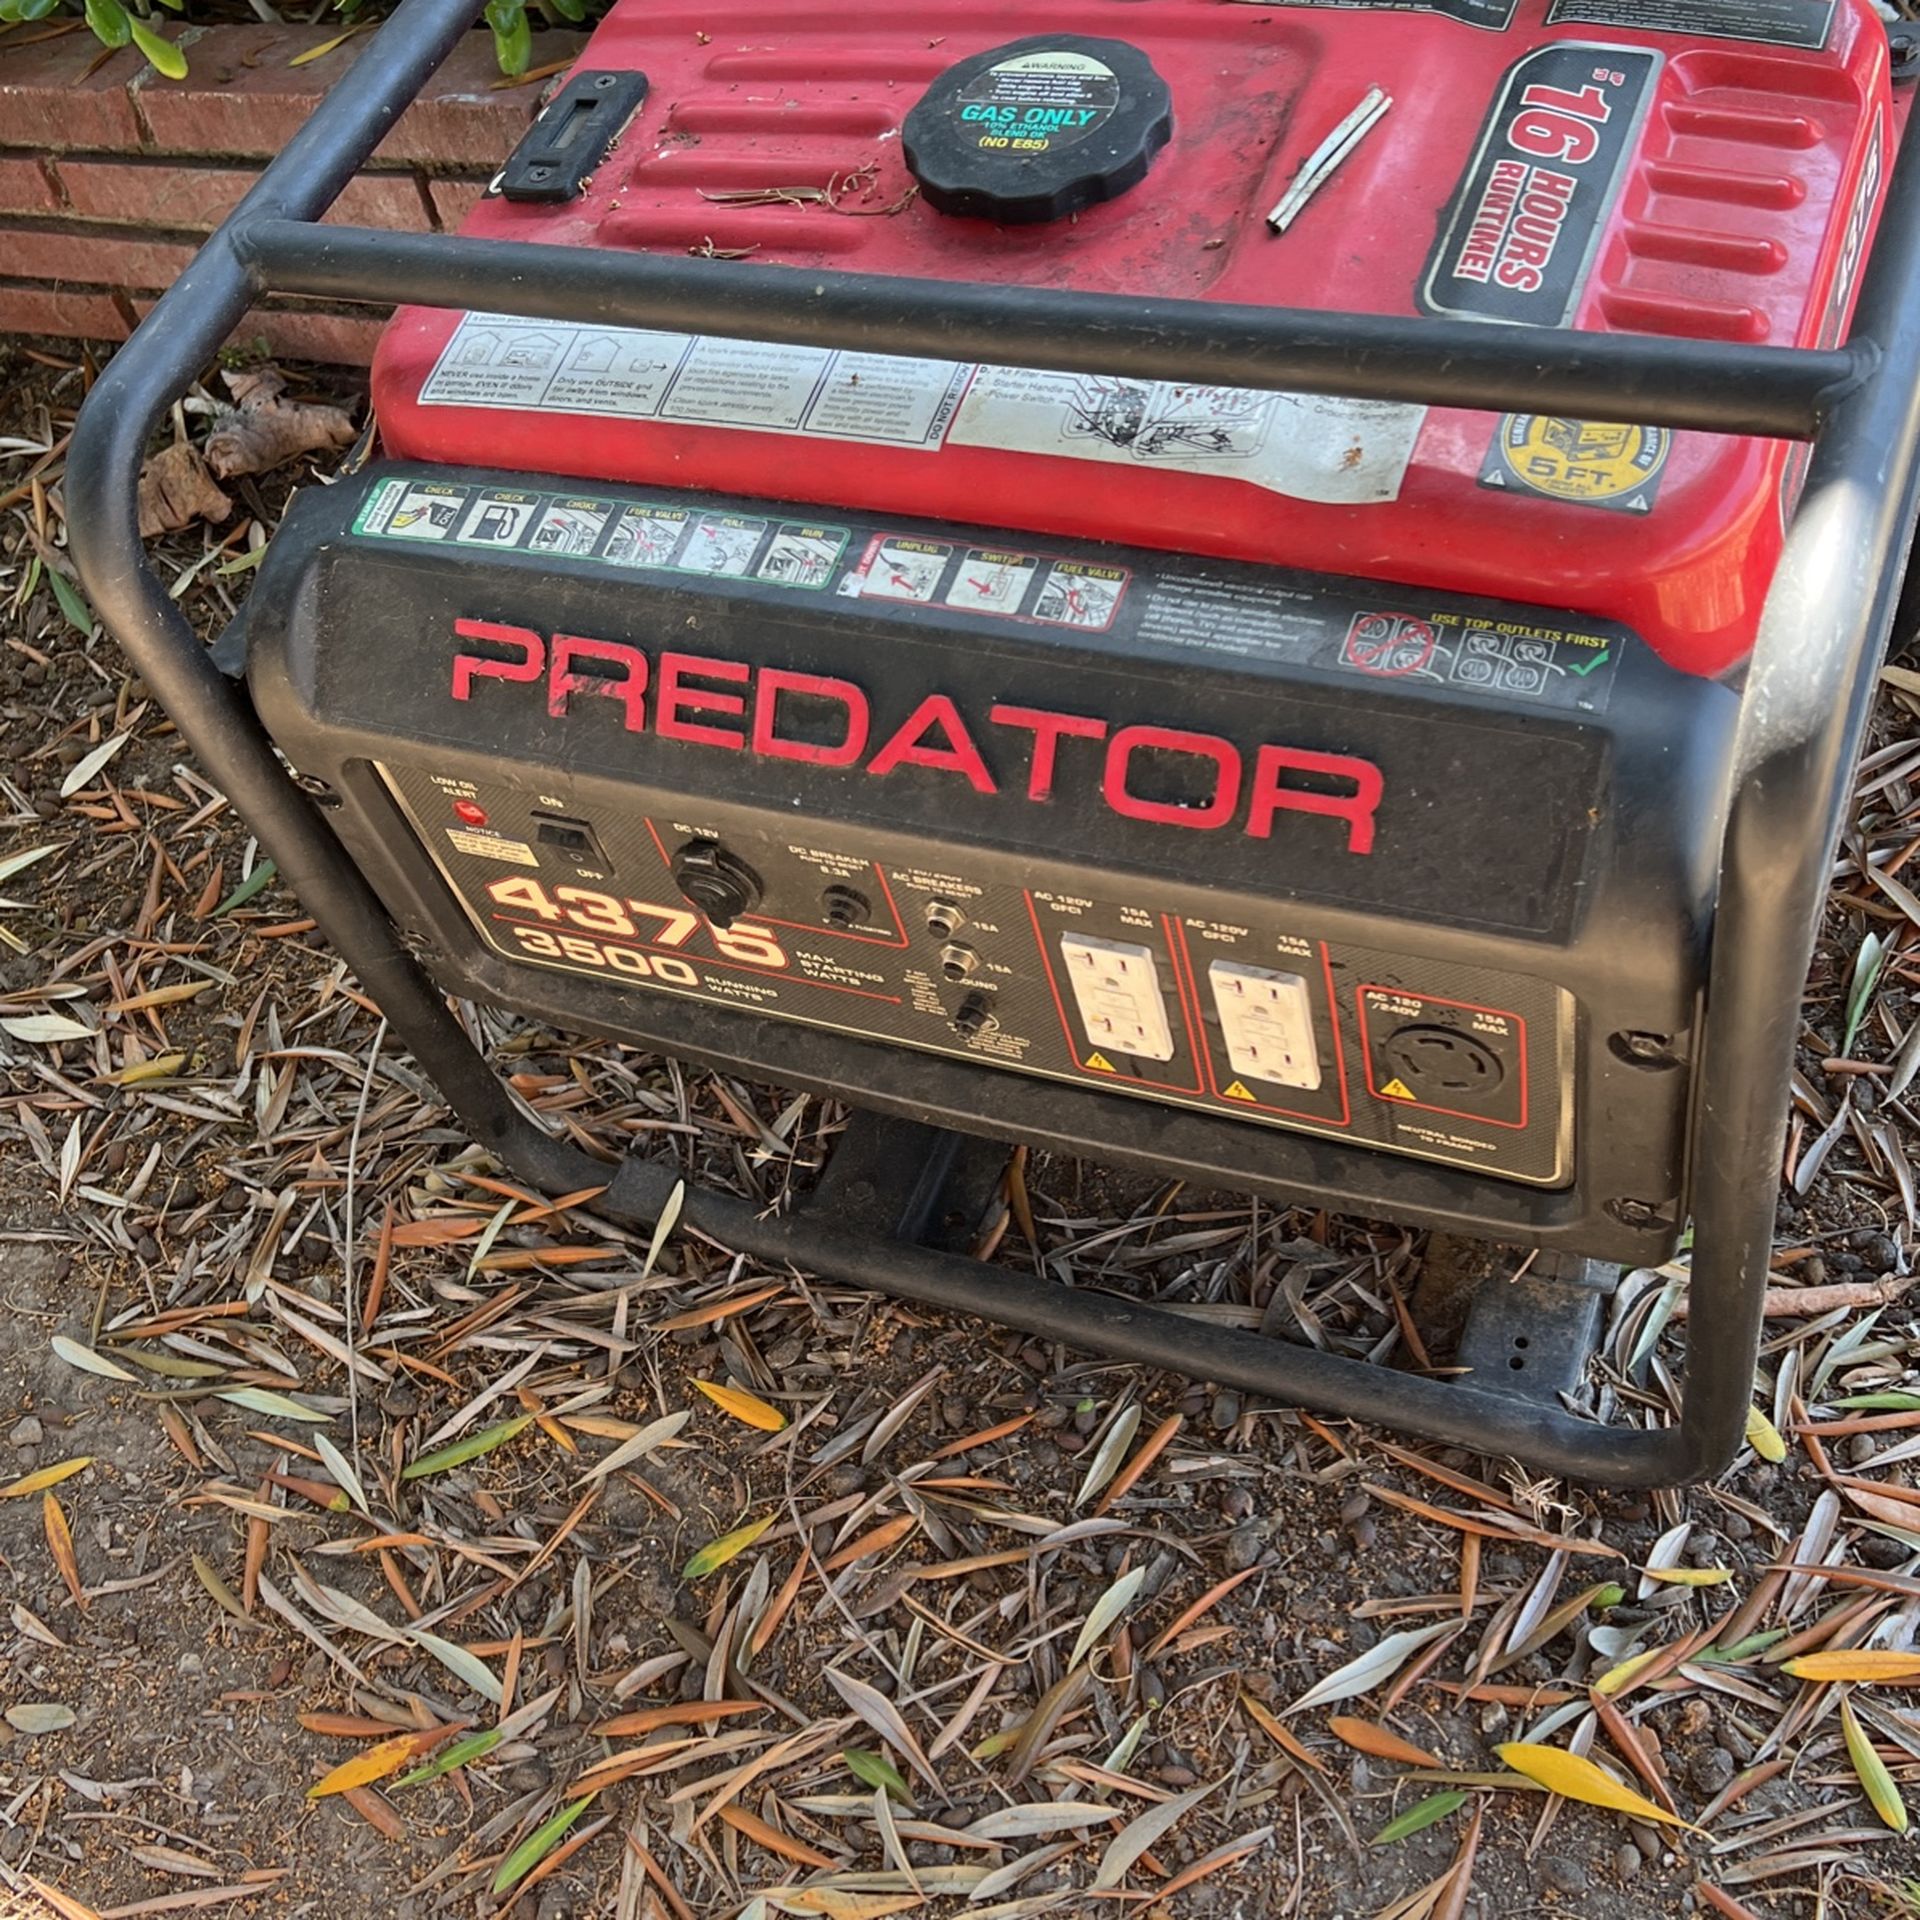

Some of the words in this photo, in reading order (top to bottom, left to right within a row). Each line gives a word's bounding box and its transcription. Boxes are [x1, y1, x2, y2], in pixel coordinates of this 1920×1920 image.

[1031, 63, 1086, 71] WARNING
[961, 104, 1018, 122] GAS
[1024, 108, 1097, 126] ONLY
[1010, 122, 1061, 132] ETHANOL
[1507, 84, 1612, 164] 16
[990, 129, 1027, 137] BLEND
[978, 136, 1009, 148] (NO
[1011, 137, 1050, 150] E85)
[1452, 160, 1530, 283] RUNTIME!
[1493, 167, 1578, 293] HOURS
[930, 423, 943, 440] DO
[937, 402, 953, 424] NOT
[948, 364, 971, 399] REMOV
[1526, 455, 1559, 476] 5
[1565, 466, 1616, 488] FT.
[424, 485, 455, 496] CHECK
[494, 492, 526, 503] CHECK
[565, 499, 598, 511] CHOKE
[628, 507, 653, 518] FUEL
[653, 509, 687, 521] VALVE
[720, 517, 746, 529] PULL
[801, 527, 825, 539] RUN
[896, 540, 939, 554] UNPLUG
[1056, 563, 1083, 576] FUEL
[1085, 566, 1121, 580] VALVE
[1431, 613, 1460, 627] USE
[1464, 617, 1493, 630] TOP
[1497, 623, 1562, 642] OUTLETS
[1565, 632, 1611, 649] FIRST
[453, 617, 1384, 854] PREDATOR
[430, 776, 457, 787] LOW
[459, 781, 478, 791] OIL
[442, 786, 477, 799] ALERT
[539, 795, 564, 808] ON
[465, 825, 502, 838] NOTICE
[673, 823, 692, 835] DC
[694, 826, 720, 839] 12V
[788, 845, 807, 855] DC
[810, 848, 870, 866] BREAKER
[576, 868, 604, 880] OFF
[892, 872, 910, 882] AC
[912, 875, 983, 895] BREAKERS
[1034, 891, 1053, 901] AC
[1057, 895, 1093, 908] 120V
[1050, 902, 1083, 915] GFCI
[1120, 906, 1150, 918] 15A
[484, 875, 790, 970] 4375
[972, 921, 999, 933] 15A
[1120, 915, 1154, 928] MAX
[1186, 918, 1206, 929] AC
[1209, 923, 1248, 936] 120V
[1202, 930, 1236, 943] GFCI
[1278, 935, 1310, 948] 15A
[513, 926, 699, 986] 3500
[795, 950, 836, 965] MAX
[1277, 944, 1312, 958] MAX
[800, 959, 885, 983] STARTING
[986, 963, 1013, 975] 15A
[803, 968, 861, 986] WATTS
[704, 975, 779, 997] RUNNING
[707, 984, 763, 1001] WATTS
[1366, 991, 1388, 1001] AC
[1391, 997, 1423, 1008] 120
[1372, 1002, 1420, 1017] /240V
[1474, 1013, 1507, 1025] 15A
[1472, 1021, 1509, 1036] MAX
